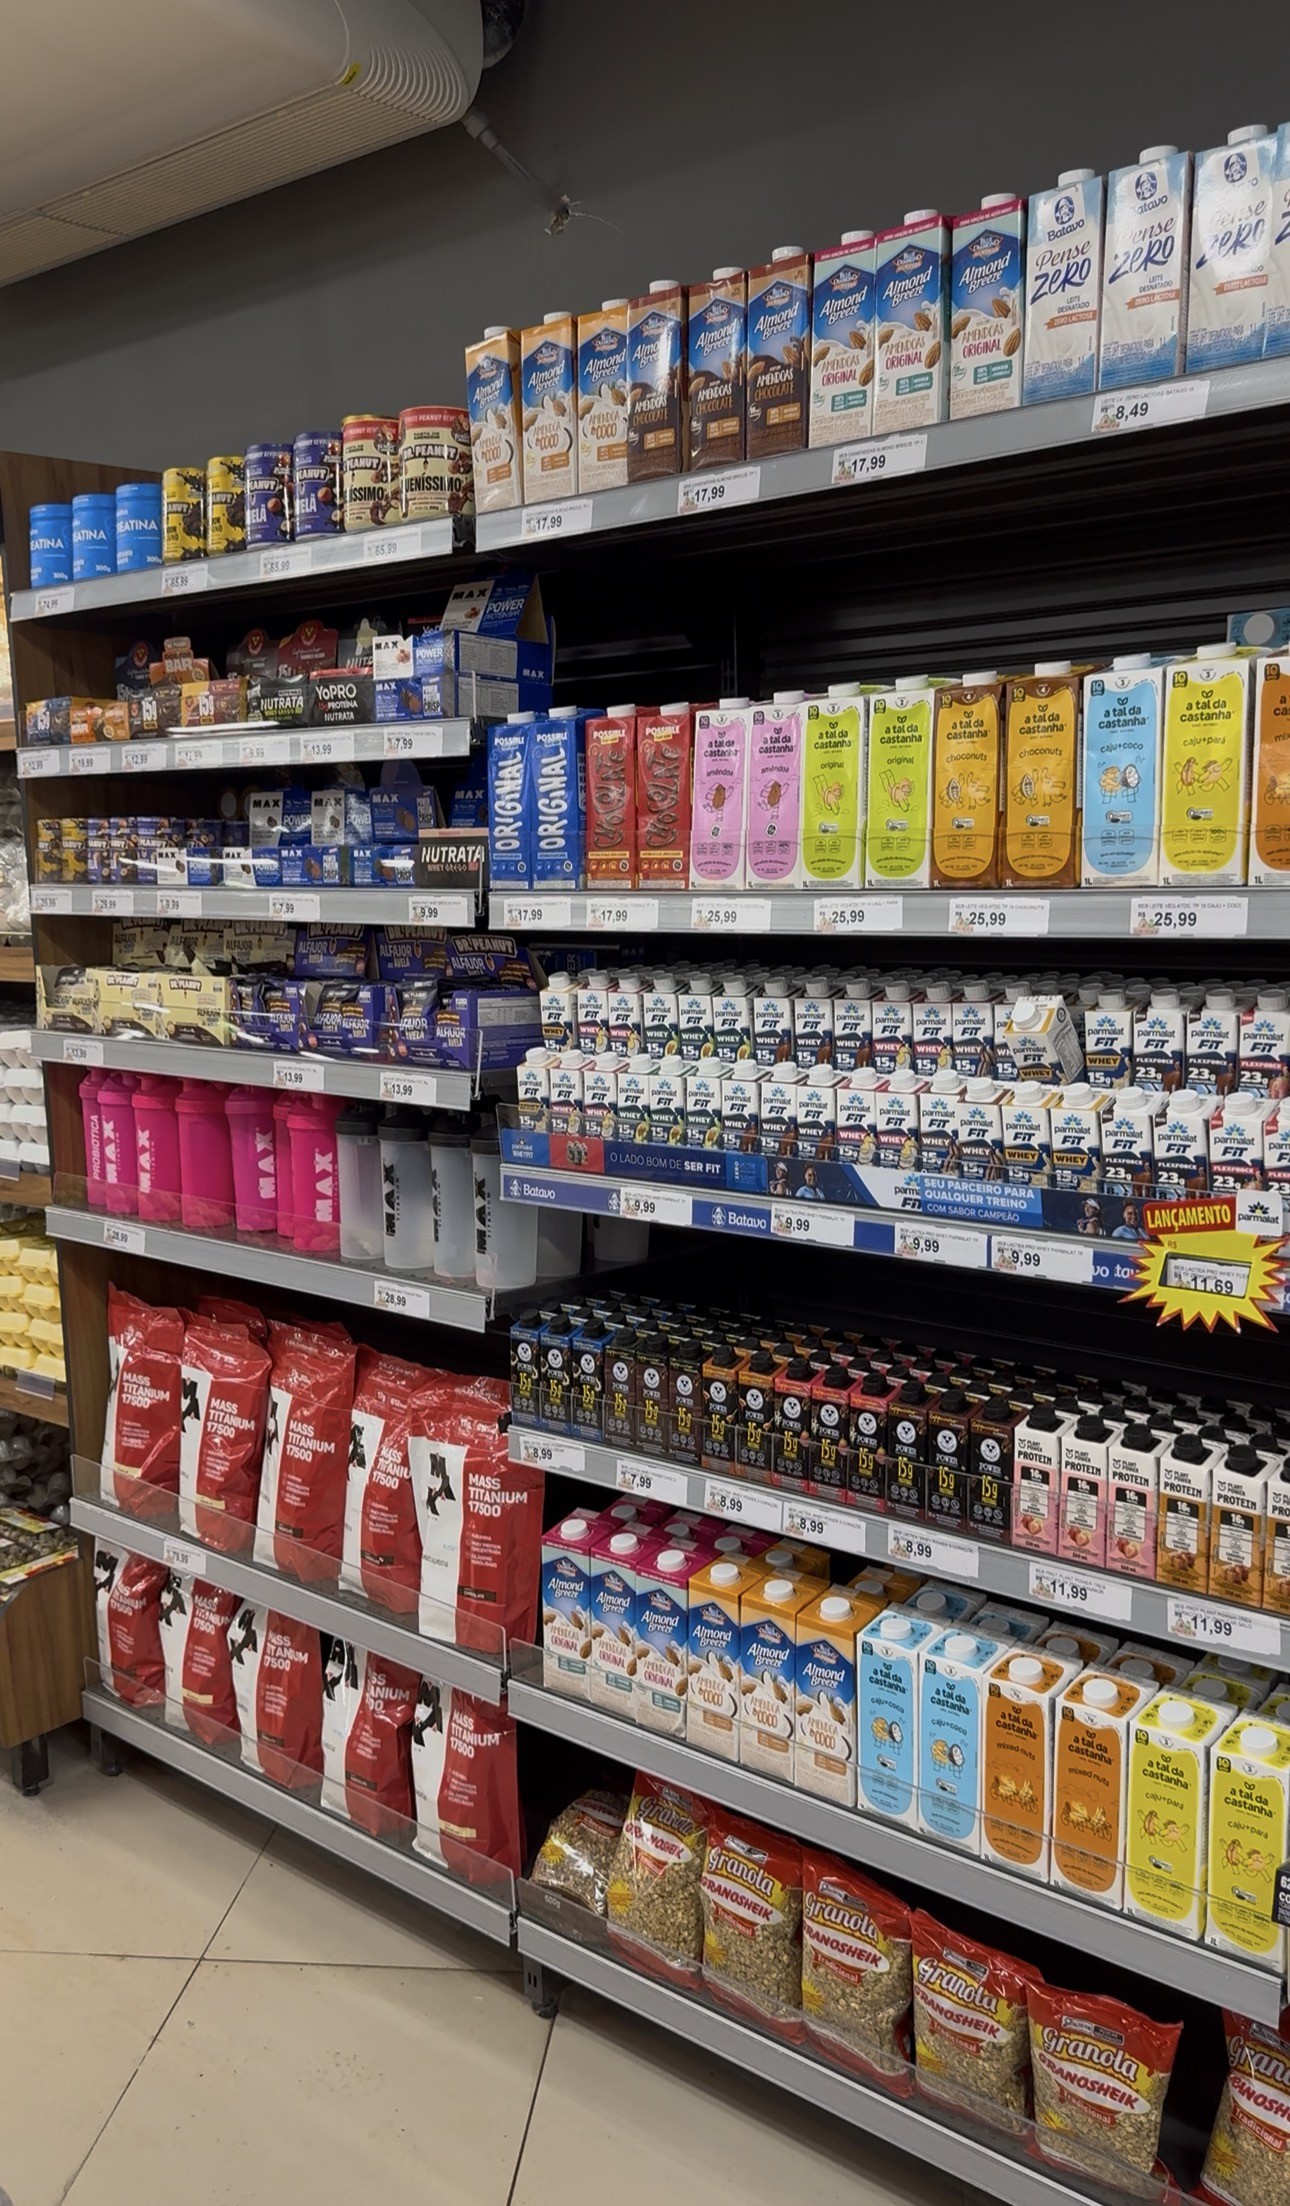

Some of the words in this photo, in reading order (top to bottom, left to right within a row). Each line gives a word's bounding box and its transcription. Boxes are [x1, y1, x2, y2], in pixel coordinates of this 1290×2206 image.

[1047, 218, 1085, 242] Batavo
[1035, 240, 1092, 271] Pense
[959, 252, 1011, 286] Almond
[883, 266, 932, 299] Almond
[969, 271, 1002, 294] Breeze
[1139, 280, 1173, 293] DESNATADO
[820, 287, 867, 318] Almond
[892, 284, 925, 307] Breeze
[1066, 295, 1081, 305] LEITE
[828, 305, 859, 325] Breeze
[1057, 301, 1090, 314] DESNATADO
[754, 302, 799, 332] Almond
[1052, 315, 1067, 326] ZERO
[1068, 312, 1093, 323] LACTOSE
[963, 339, 1001, 359] ORIGINAL
[755, 382, 794, 401] CHOCOLATE
[1116, 402, 1148, 421] 8,49
[415, 445, 458, 460] PEANUT
[852, 455, 886, 473] 17,99
[694, 486, 725, 503] 17,99
[535, 516, 562, 530] 17,99
[146, 556, 162, 564] 300g
[95, 564, 111, 572] 300g
[486, 599, 525, 613] POWER
[484, 612, 510, 620] PROTEIN
[416, 649, 443, 658] POWER
[166, 659, 192, 672] BAR
[316, 684, 356, 700] YoPRO
[260, 696, 304, 710] NUTRATA
[1196, 700, 1211, 710] tal
[1213, 700, 1227, 709] da
[1180, 712, 1232, 723] castanha
[593, 730, 625, 739] POSSIBLE
[1019, 724, 1064, 734] castanha
[537, 732, 567, 743] POSSIBLE
[880, 735, 922, 743] castanha
[887, 757, 914, 765] original
[946, 753, 987, 762] choconuts
[1019, 749, 1062, 758] choconuts
[820, 761, 844, 769] original
[252, 799, 280, 808] MAX
[495, 752, 523, 850] ORIGINAL
[538, 747, 567, 850] ORIGINAL
[422, 846, 485, 863] NUTRATA
[1085, 877, 1092, 885] 1L
[707, 911, 736, 923] 25,99
[969, 912, 1006, 927] 25,99
[1155, 912, 1197, 929] 25,99
[380, 944, 412, 957] ALFAJOR
[474, 937, 515, 954] PEANUT
[452, 957, 485, 970] ALFAJOR
[1088, 1027, 1124, 1038] parmalat
[1137, 1030, 1175, 1041] parmalat
[797, 1052, 815, 1063] 15g
[1088, 1056, 1119, 1065] WHEY
[284, 1073, 302, 1083] 13,99
[1088, 1072, 1111, 1084] 15g
[1136, 1067, 1162, 1080] 23g
[91, 1115, 100, 1180] PROBIOTICA
[139, 1129, 150, 1194] MAX
[256, 1131, 276, 1199] MAX
[610, 1152, 617, 1162] O
[619, 1154, 644, 1165] LADO
[646, 1156, 667, 1168] BOM
[669, 1159, 682, 1169] DE
[684, 1161, 703, 1172] SER
[705, 1163, 721, 1174] FIT
[1158, 1162, 1198, 1170] FLEXFORCE
[523, 1185, 556, 1199] Batavo
[924, 1178, 947, 1189] SEU
[949, 1180, 1001, 1193] PARCEIRO
[1005, 1187, 1034, 1198] PARA
[925, 1190, 984, 1204] QUALQUER
[986, 1195, 1027, 1209] TREINO
[927, 1203, 946, 1213] COM
[948, 1206, 975, 1217] SABOR
[978, 1205, 1019, 1222] CAMPEÃO
[1147, 1205, 1231, 1231] LANÇAMENTO
[1238, 1213, 1279, 1224] parmalat
[728, 1212, 767, 1229] Batavo
[785, 1217, 810, 1231] 9,99
[913, 1238, 939, 1253] 9,99
[1168, 1241, 1177, 1249] R$
[1012, 1251, 1040, 1267] 9,99
[385, 1293, 406, 1306] 28,99
[123, 1371, 151, 1386] MASS
[123, 1383, 169, 1401] TITANIUM
[122, 1394, 150, 1409] 17500
[211, 1399, 238, 1414] MASS
[209, 1411, 254, 1430] TITANIUM
[207, 1422, 235, 1438] 17500
[1018, 1451, 1052, 1465] PROTEIN
[1065, 1461, 1101, 1476] PROTEIN
[1174, 1471, 1188, 1479] PLANT
[469, 1473, 500, 1489] MASS
[630, 1475, 651, 1489] 7,99
[469, 1488, 527, 1503] TITANIUM
[1164, 1481, 1202, 1497] PROTEIN
[468, 1501, 501, 1518] 17500
[719, 1497, 742, 1511] 8,99
[906, 1540, 932, 1557] 8,99
[1050, 1580, 1087, 1600] 11,99
[1191, 1616, 1232, 1636] 11,99
[1068, 1767, 1095, 1782] mixed
[1097, 1774, 1110, 1787] nuts
[702, 1876, 773, 1921] GRANOSHEIK
[806, 1892, 878, 1942] Granola
[818, 1954, 858, 1982] Tradicional
[918, 1957, 998, 2012] Granola
[934, 2022, 976, 2052] Tradicional
[1043, 2027, 1138, 2081] Granola
[1039, 2052, 1139, 2110] GRANOSHEIK
[1065, 2092, 1111, 2124] Tradicional
[1236, 2107, 1281, 2148] Tradicional
